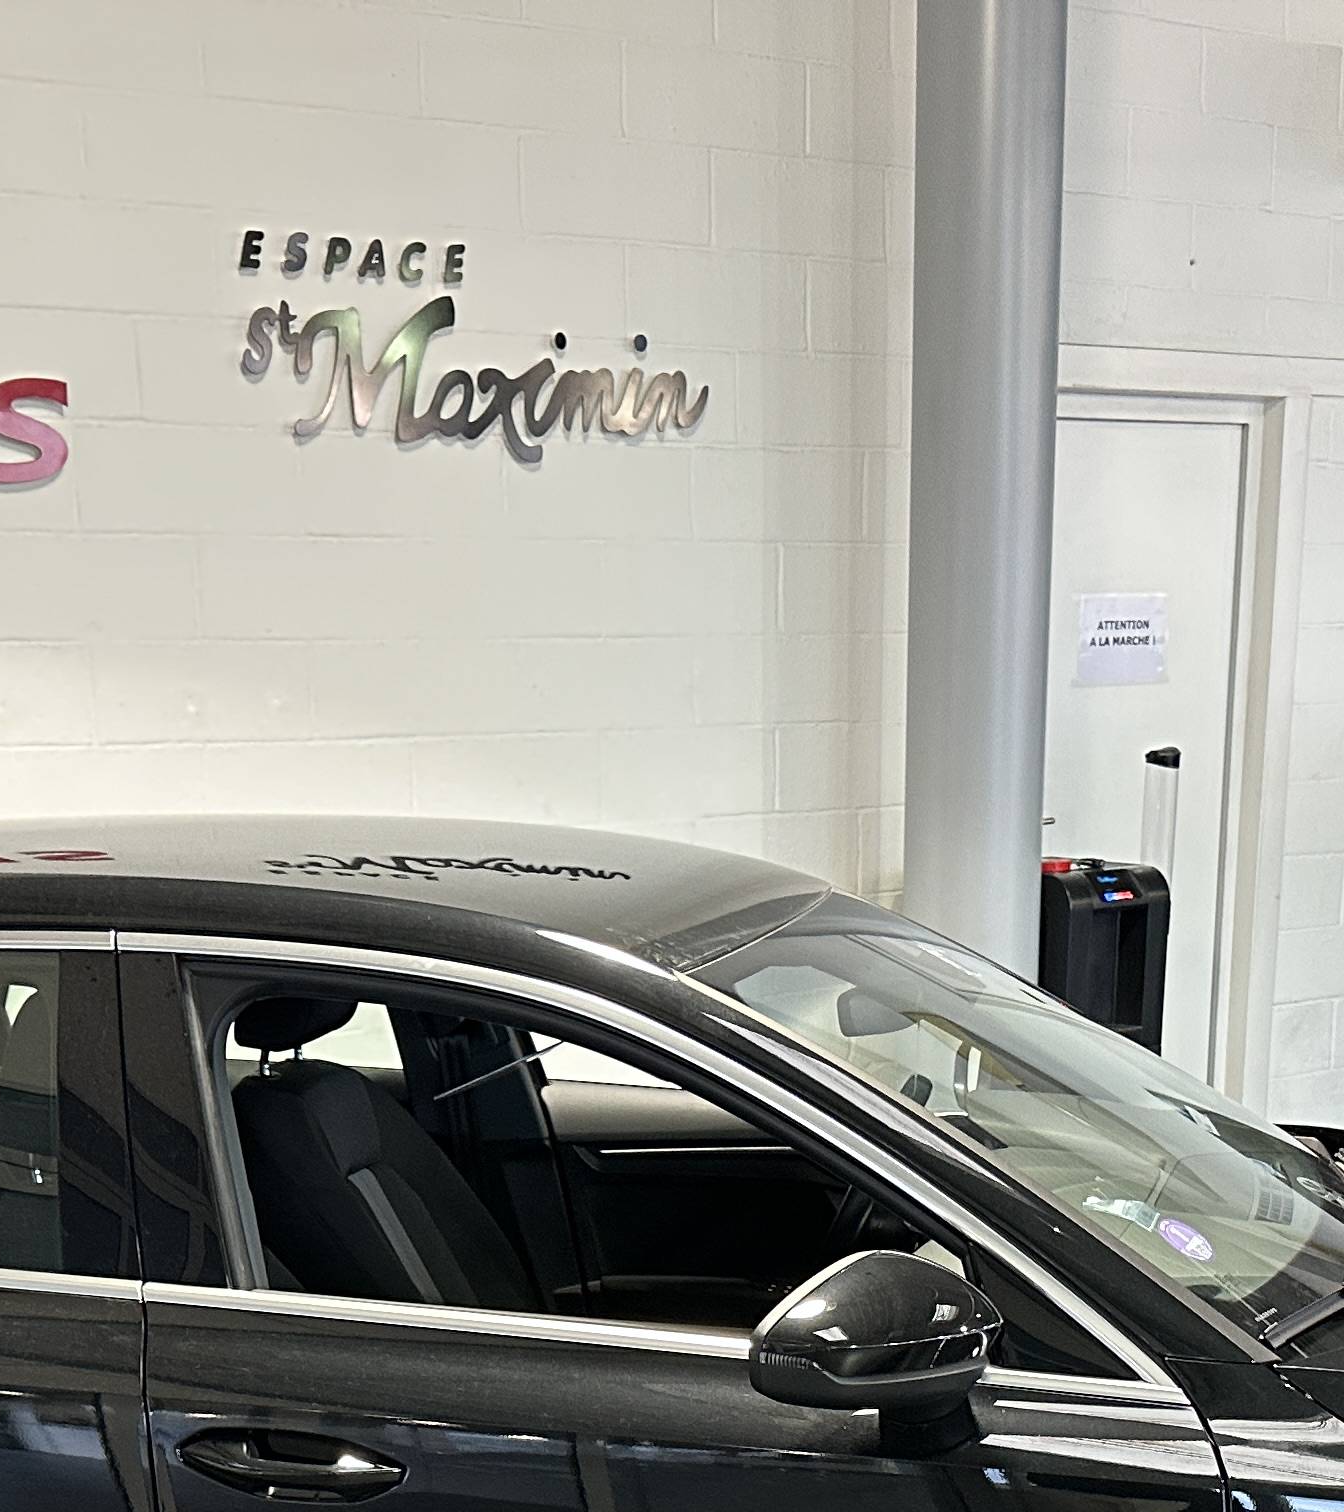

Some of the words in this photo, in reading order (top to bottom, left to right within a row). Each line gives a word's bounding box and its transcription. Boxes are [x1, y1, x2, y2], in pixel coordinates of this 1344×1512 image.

[239, 230, 465, 283] ESPACE
[294, 296, 709, 463] Maximin
[1096, 619, 1150, 630] ATTENTION
[1089, 636, 1097, 647] A
[1099, 636, 1111, 647] LA
[1112, 635, 1150, 646] MARCHE
